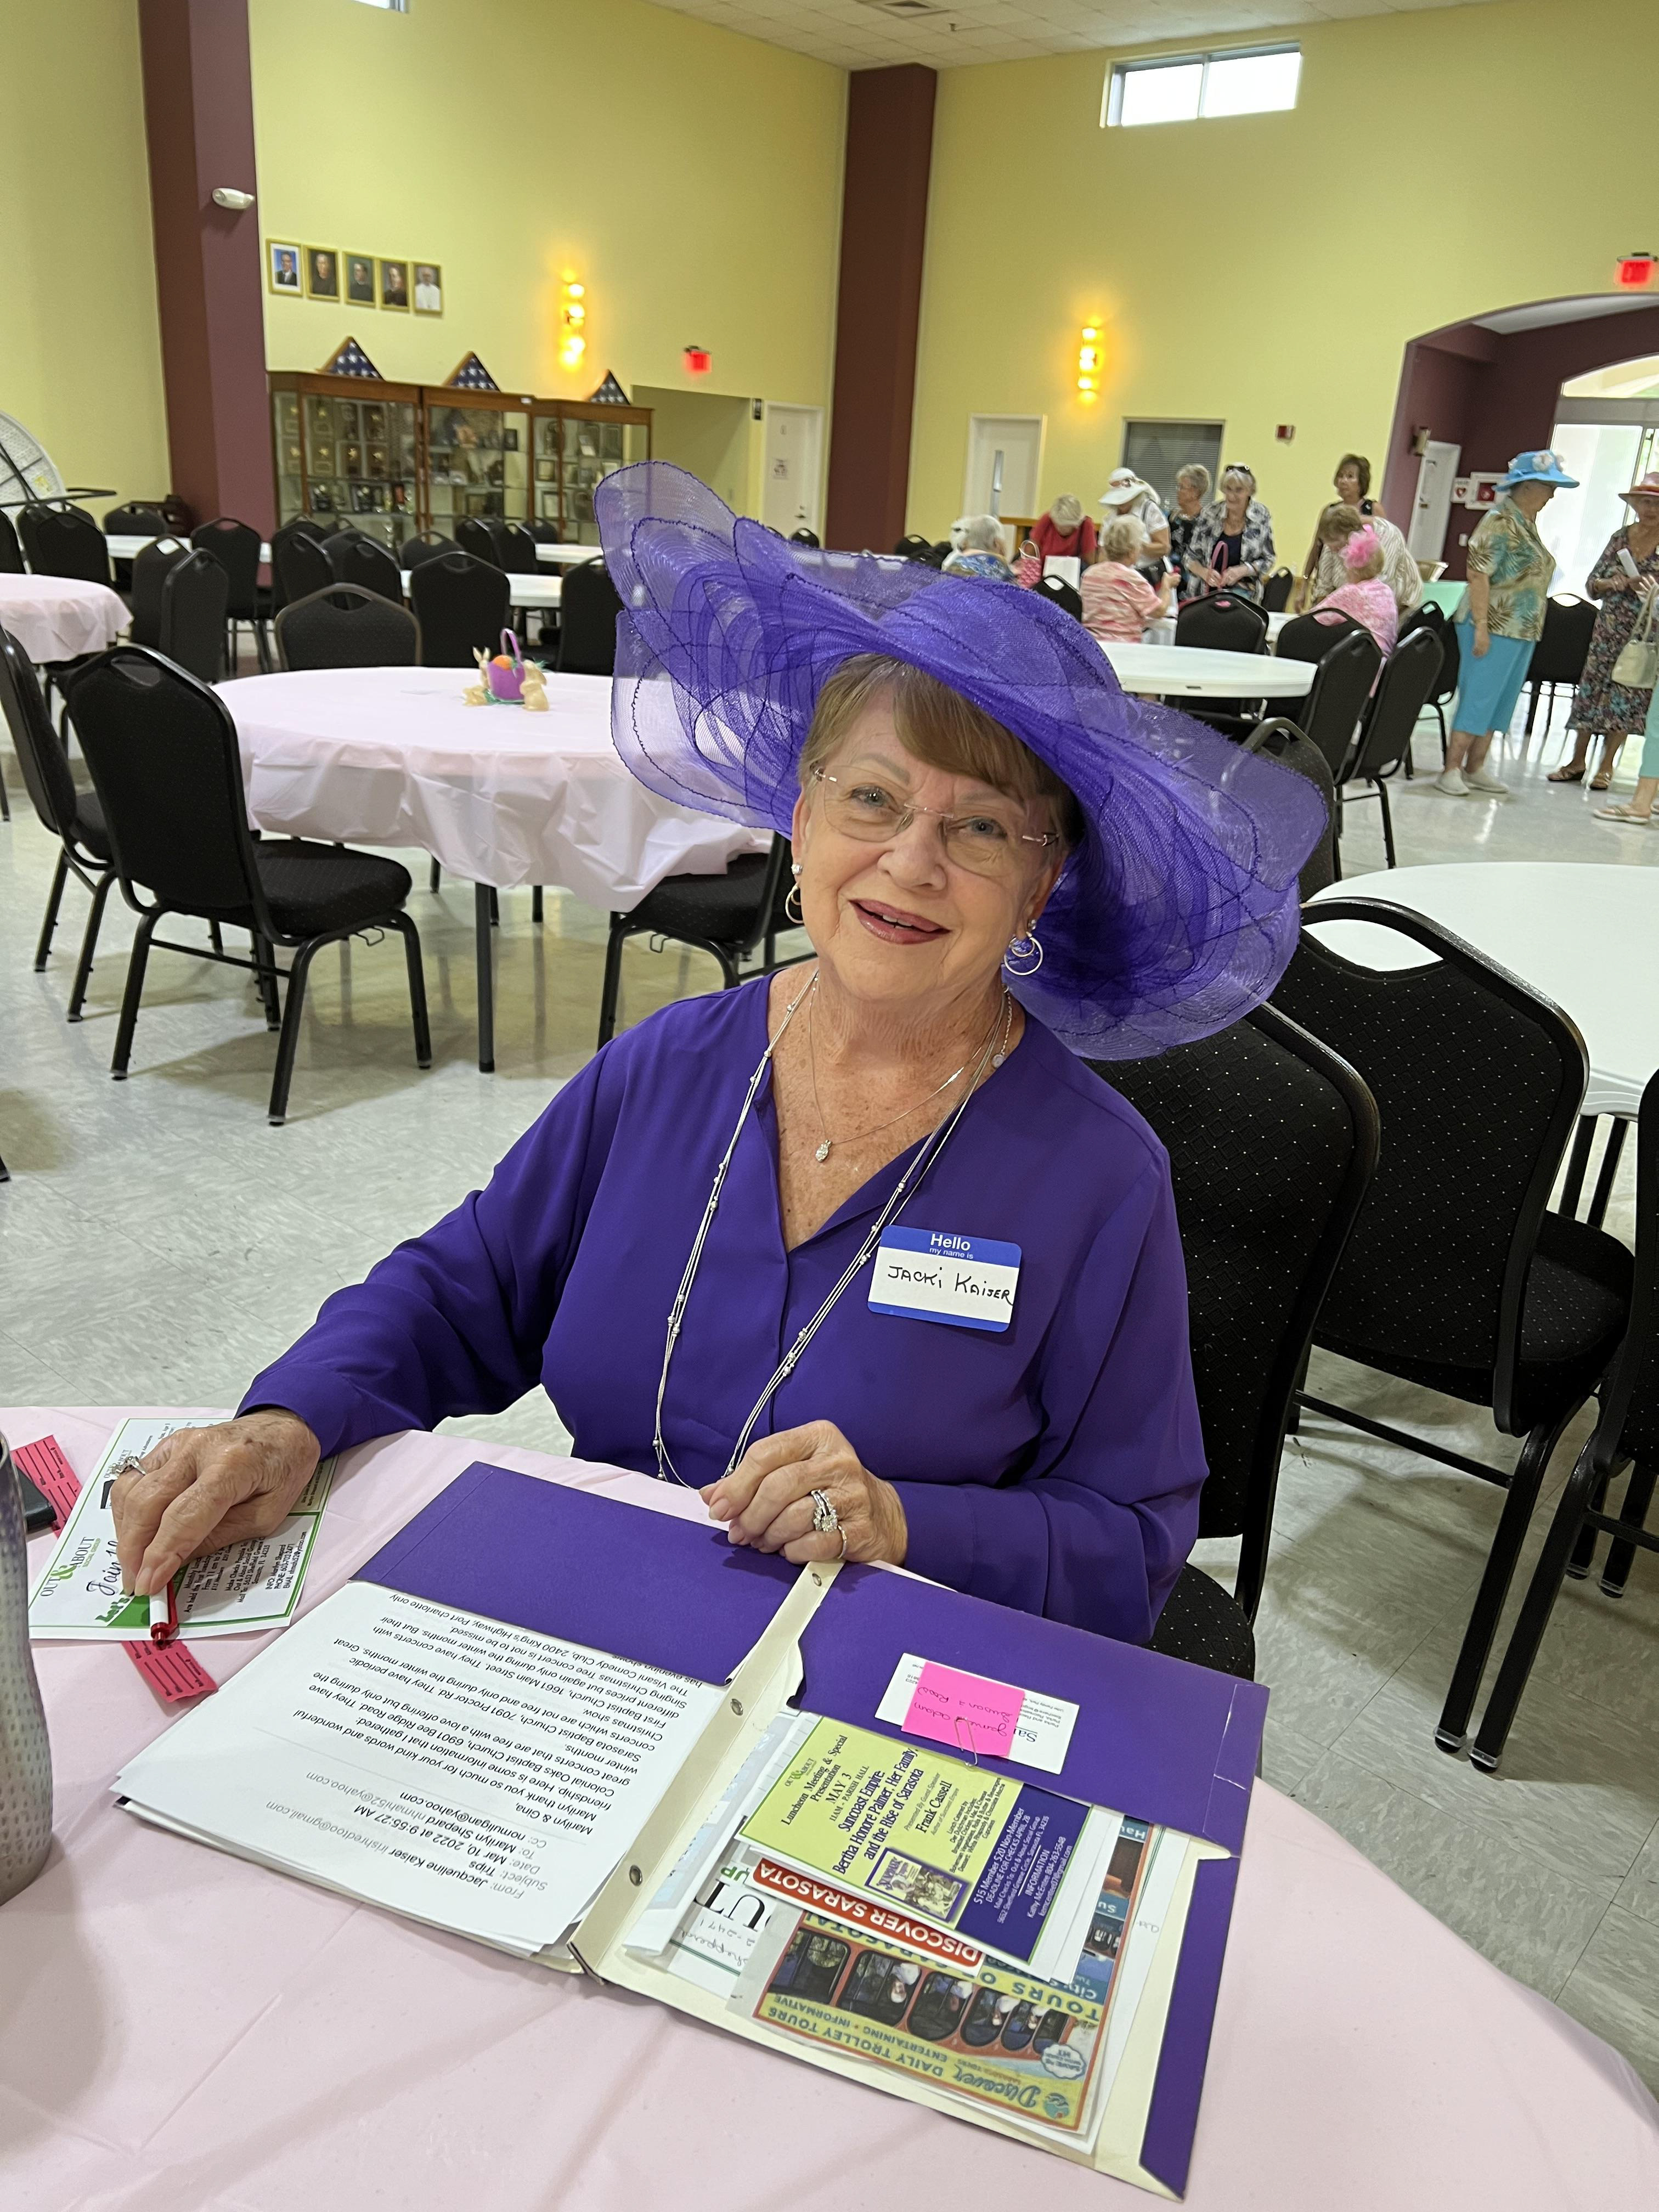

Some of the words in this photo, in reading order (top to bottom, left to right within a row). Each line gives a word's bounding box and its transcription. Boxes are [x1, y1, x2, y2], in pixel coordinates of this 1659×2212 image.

[930, 1233, 971, 1251] Hello
[929, 1248, 941, 1256] my
[943, 1249, 964, 1258] name
[69, 1537, 94, 1568] ABOUT
[242, 1553, 252, 1565] Social
[261, 1545, 270, 1558] 34235
[275, 1544, 286, 1561] Shepard
[280, 1543, 295, 1572] 603-702-2471
[50, 1564, 76, 1579] &
[238, 1565, 247, 1578] About
[270, 1561, 282, 1577] Marilyn
[40, 1577, 61, 1597] OUT
[86, 1562, 122, 1597] Join
[183, 1570, 200, 1589] Monthly
[234, 1583, 242, 1591] Out
[266, 1577, 275, 1589] INFO:
[309, 1685, 332, 1698] have
[332, 1693, 356, 1707] They
[359, 1703, 386, 1718] Road.
[293, 1711, 342, 1730] wonderful
[356, 1718, 403, 1737] gathered:
[387, 1714, 416, 1729] Ridge
[342, 1728, 364, 1739] and
[417, 1725, 437, 1736] Bee
[437, 1732, 463, 1745] 6901
[364, 1736, 394, 1750] words
[408, 1736, 428, 1748] that
[468, 1740, 504, 1759] Church,
[394, 1747, 418, 1760] kind
[418, 1756, 443, 1767] your
[430, 1745, 486, 1768] information
[442, 1764, 458, 1774] for
[488, 1764, 516, 1777] some
[506, 1756, 542, 1771] Baptist
[798, 1758, 814, 1774] ABOUT
[459, 1769, 488, 1783] much
[518, 1774, 528, 1782] is
[544, 1768, 569, 1781] Oaks
[781, 1793, 808, 1825] Luncheon
[804, 1766, 828, 1791] Meeting
[827, 1735, 847, 1756] Special
[785, 1774, 796, 1786] OUT
[789, 1770, 804, 1779] &
[810, 1764, 840, 1801] Presentation
[504, 1785, 525, 1795] you
[529, 1778, 554, 1792] Here
[571, 1778, 614, 1796] Colonial
[825, 1780, 845, 1803] MAY
[896, 1769, 923, 1800] Sarasota
[307, 1773, 425, 1819] nhmahi52@yahoo.com
[526, 1792, 555, 1807] thank
[558, 1787, 611, 1810] friendship.
[829, 1805, 843, 1821] 11AM
[842, 1780, 859, 1801] PARISH
[855, 1766, 869, 1780] HALL
[838, 1796, 868, 1831] Suncoast
[859, 1771, 884, 1797] Empire:
[904, 1807, 920, 1831] Presented
[920, 1788, 931, 1802] Guest
[927, 1772, 940, 1790] Speaker
[354, 1805, 375, 1816] AM
[516, 1803, 539, 1818] Gina,
[557, 1803, 596, 1820] Marilyn
[893, 1798, 904, 1809] of
[915, 1809, 936, 1833] Frank
[929, 1780, 951, 1808] Cassell
[374, 1814, 419, 1833] 9:55:27
[400, 1793, 524, 1839] nomuligan@yahoo.com
[543, 1814, 551, 1822] &
[832, 1845, 859, 1874] Bertha
[850, 1814, 877, 1844] Honoré
[868, 1787, 894, 1814] Palmer,
[885, 1771, 902, 1786] Her
[879, 1810, 899, 1828] Rise
[267, 1802, 387, 1852] irishredtoo@gmail.com
[420, 1829, 432, 1837] at
[425, 1817, 473, 1838] Shepard
[553, 1818, 592, 1834] Marilyn
[872, 1827, 888, 1842] the
[433, 1834, 464, 1850] 2022
[467, 1844, 480, 1856] 10,
[475, 1833, 516, 1853] Marilyn
[528, 1837, 546, 1848] Cc:
[864, 1841, 880, 1859] and
[388, 1849, 425, 1866] Kaiser
[483, 1852, 506, 1864] Mar
[519, 1848, 534, 1859] To:
[973, 1889, 986, 1904] $15
[980, 1861, 998, 1889] Member
[994, 1847, 1005, 1861] $20
[1000, 1808, 1023, 1848] Non-Member
[985, 1873, 1003, 1902] DEADLINE
[998, 1860, 1009, 1873] FOR
[1005, 1838, 1019, 1860] CHECKS
[1015, 1824, 1027, 1839] APRIL
[1022, 1815, 1030, 1823] 28
[426, 1863, 487, 1886] Jacqueline
[469, 1861, 495, 1876] Trips
[509, 1859, 540, 1874] Date:
[1025, 1849, 1049, 1895] INFORMATION
[500, 1871, 547, 1890] Subject:
[490, 1883, 524, 1898] From:
[761, 1865, 865, 1916] SARASOTA
[1027, 1900, 1040, 1917] Kathy
[1034, 1875, 1049, 1900] McEntee
[693, 1878, 771, 1932] UT
[871, 1910, 978, 1960] DISCOVER
[1011, 1981, 1099, 2022] TOURS
[768, 2006, 816, 2032] TOURS
[773, 1994, 849, 2027] INFORMATIVE
[822, 2027, 890, 2058] TROLLEY
[862, 2026, 947, 2062] ENTERTAINING
[895, 2053, 943, 2076] DAILY
[953, 2059, 1040, 2107] Discover
